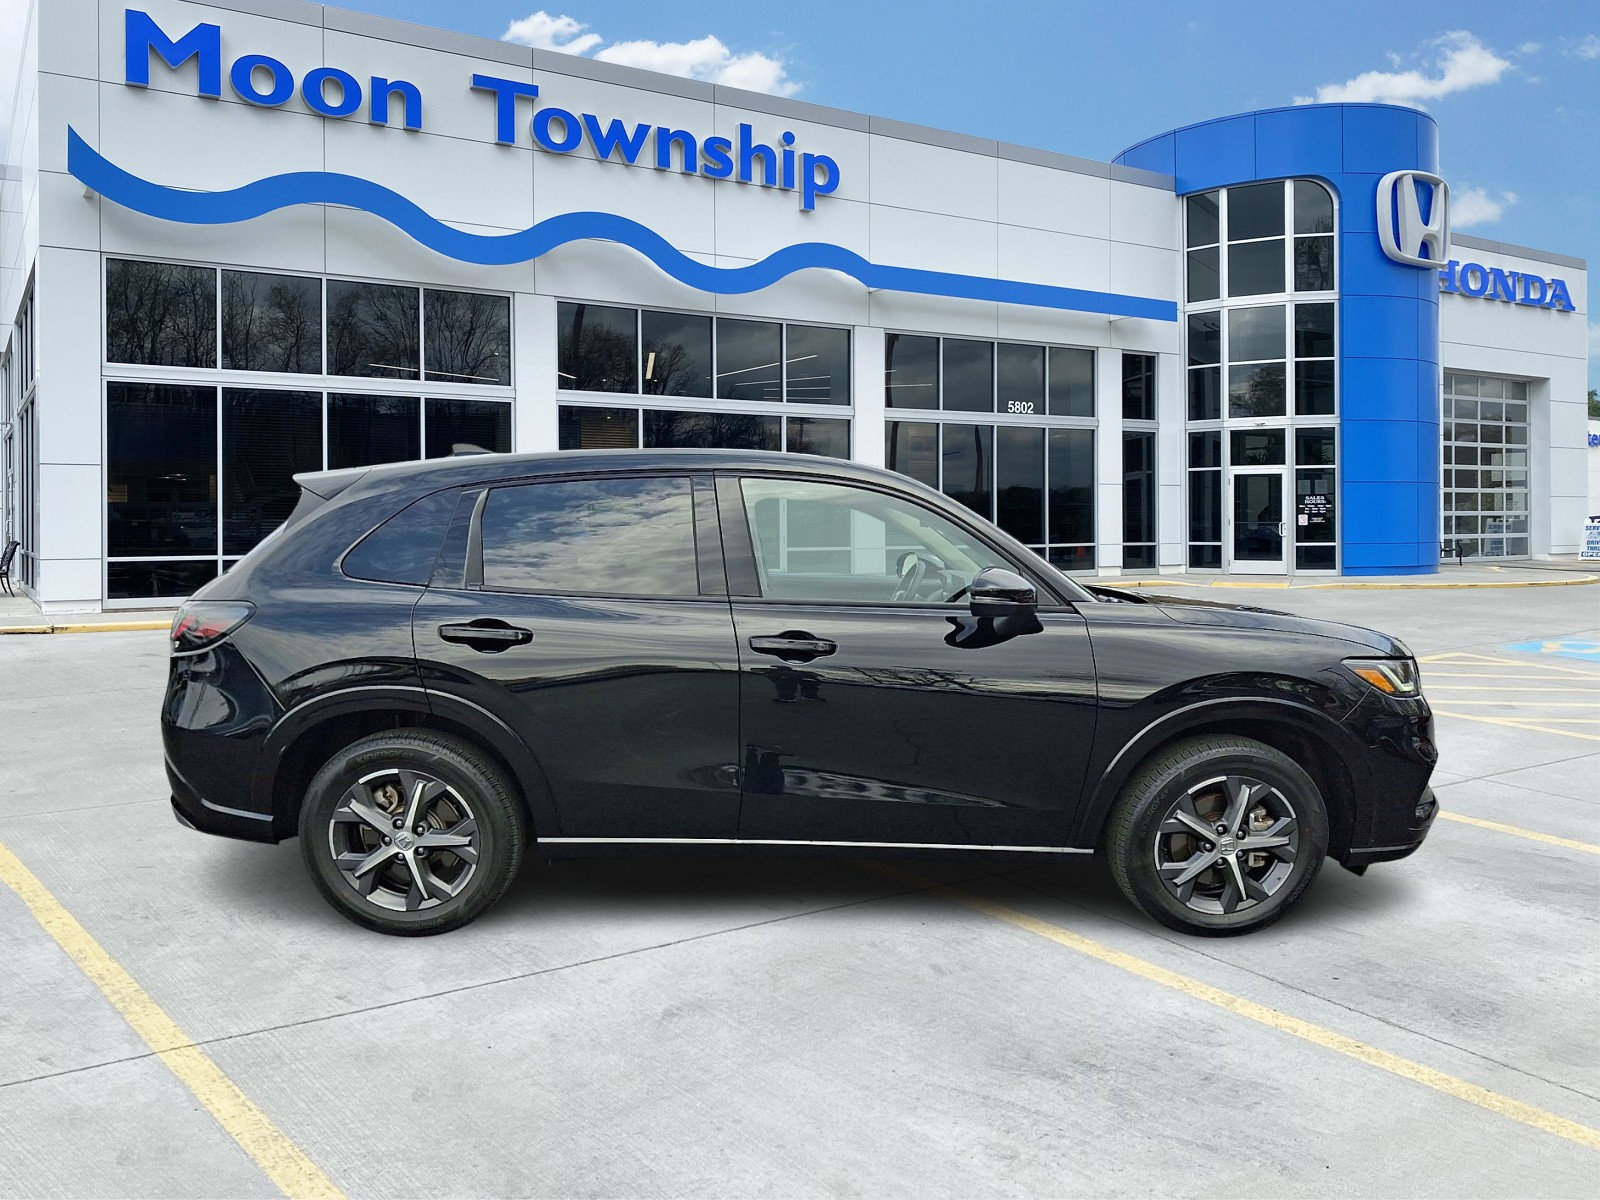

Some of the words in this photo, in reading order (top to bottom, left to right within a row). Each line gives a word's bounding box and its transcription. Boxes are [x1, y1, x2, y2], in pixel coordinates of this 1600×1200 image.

[125, 8, 422, 131] Moon
[470, 73, 841, 212] Township
[1007, 400, 1034, 414] 5802
